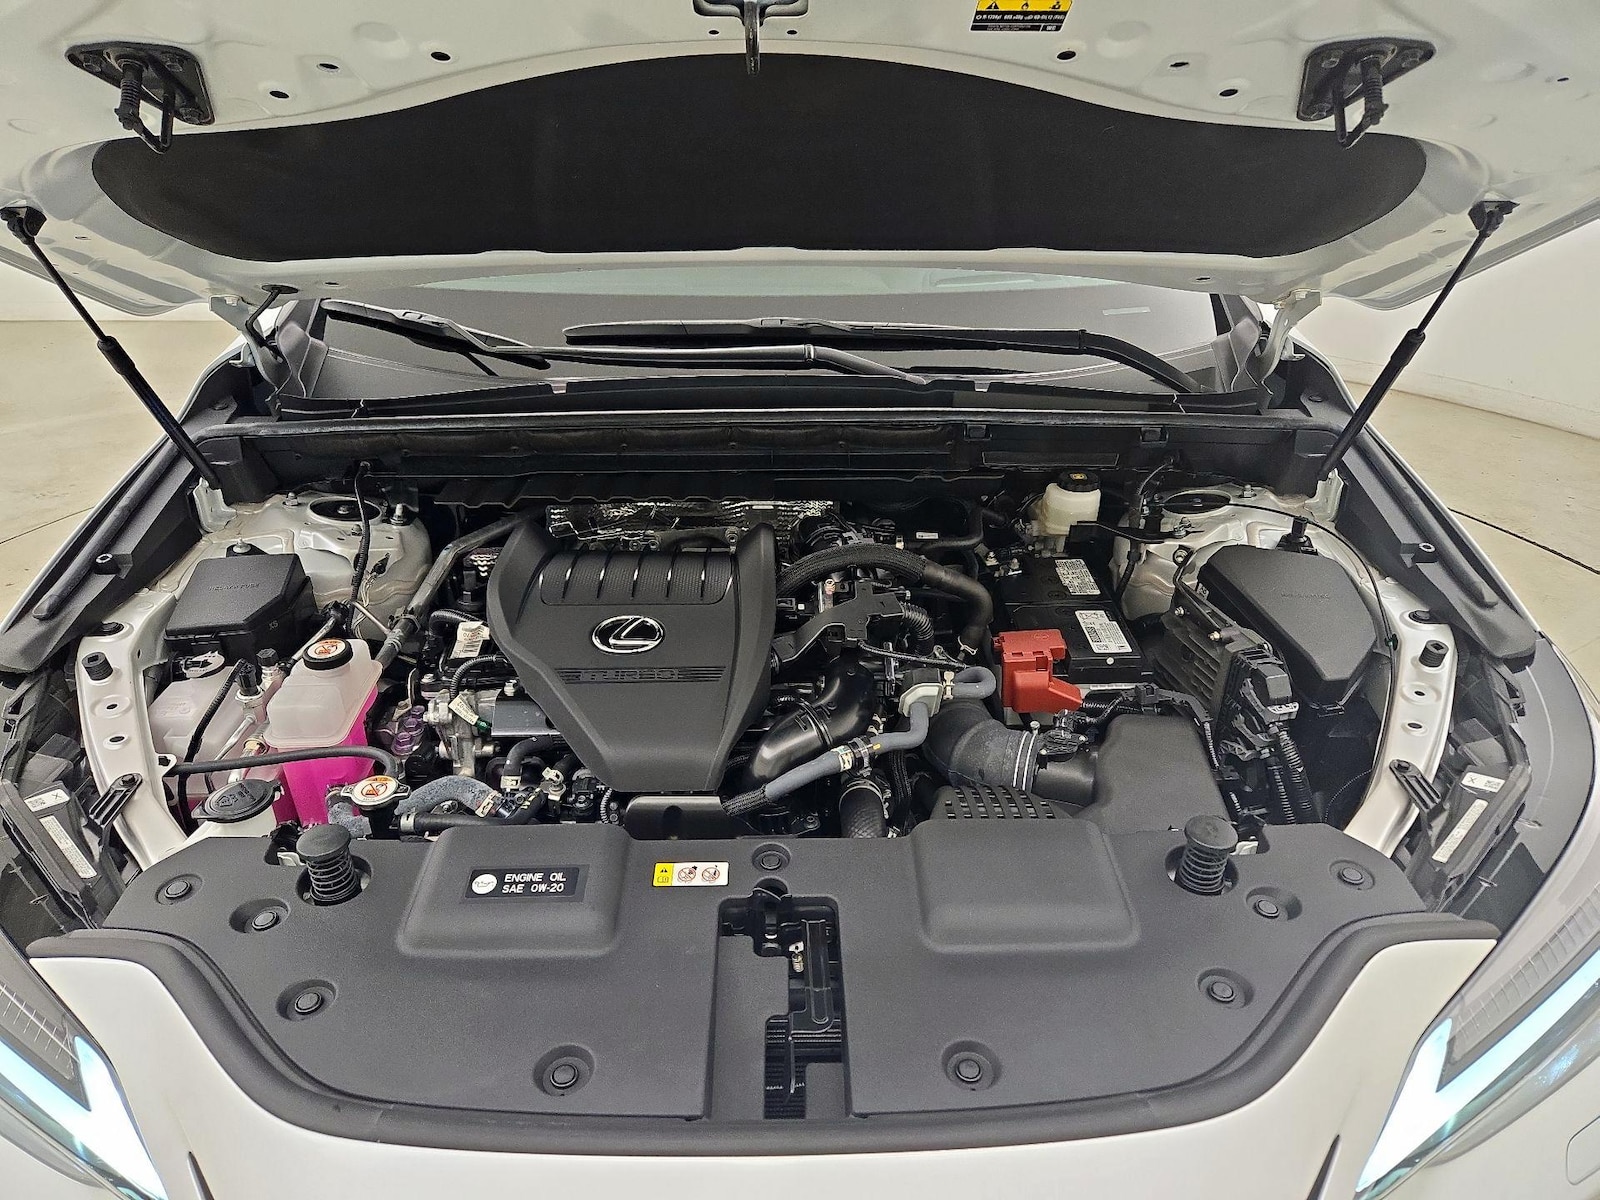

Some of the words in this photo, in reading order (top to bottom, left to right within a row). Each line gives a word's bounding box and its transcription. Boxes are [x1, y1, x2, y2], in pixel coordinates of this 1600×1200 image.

[580, 668, 680, 681] TURBO
[504, 872, 544, 882] ENGINE
[549, 872, 567, 882] OIL
[502, 884, 525, 894] SAE
[530, 883, 565, 893] 0W-20
